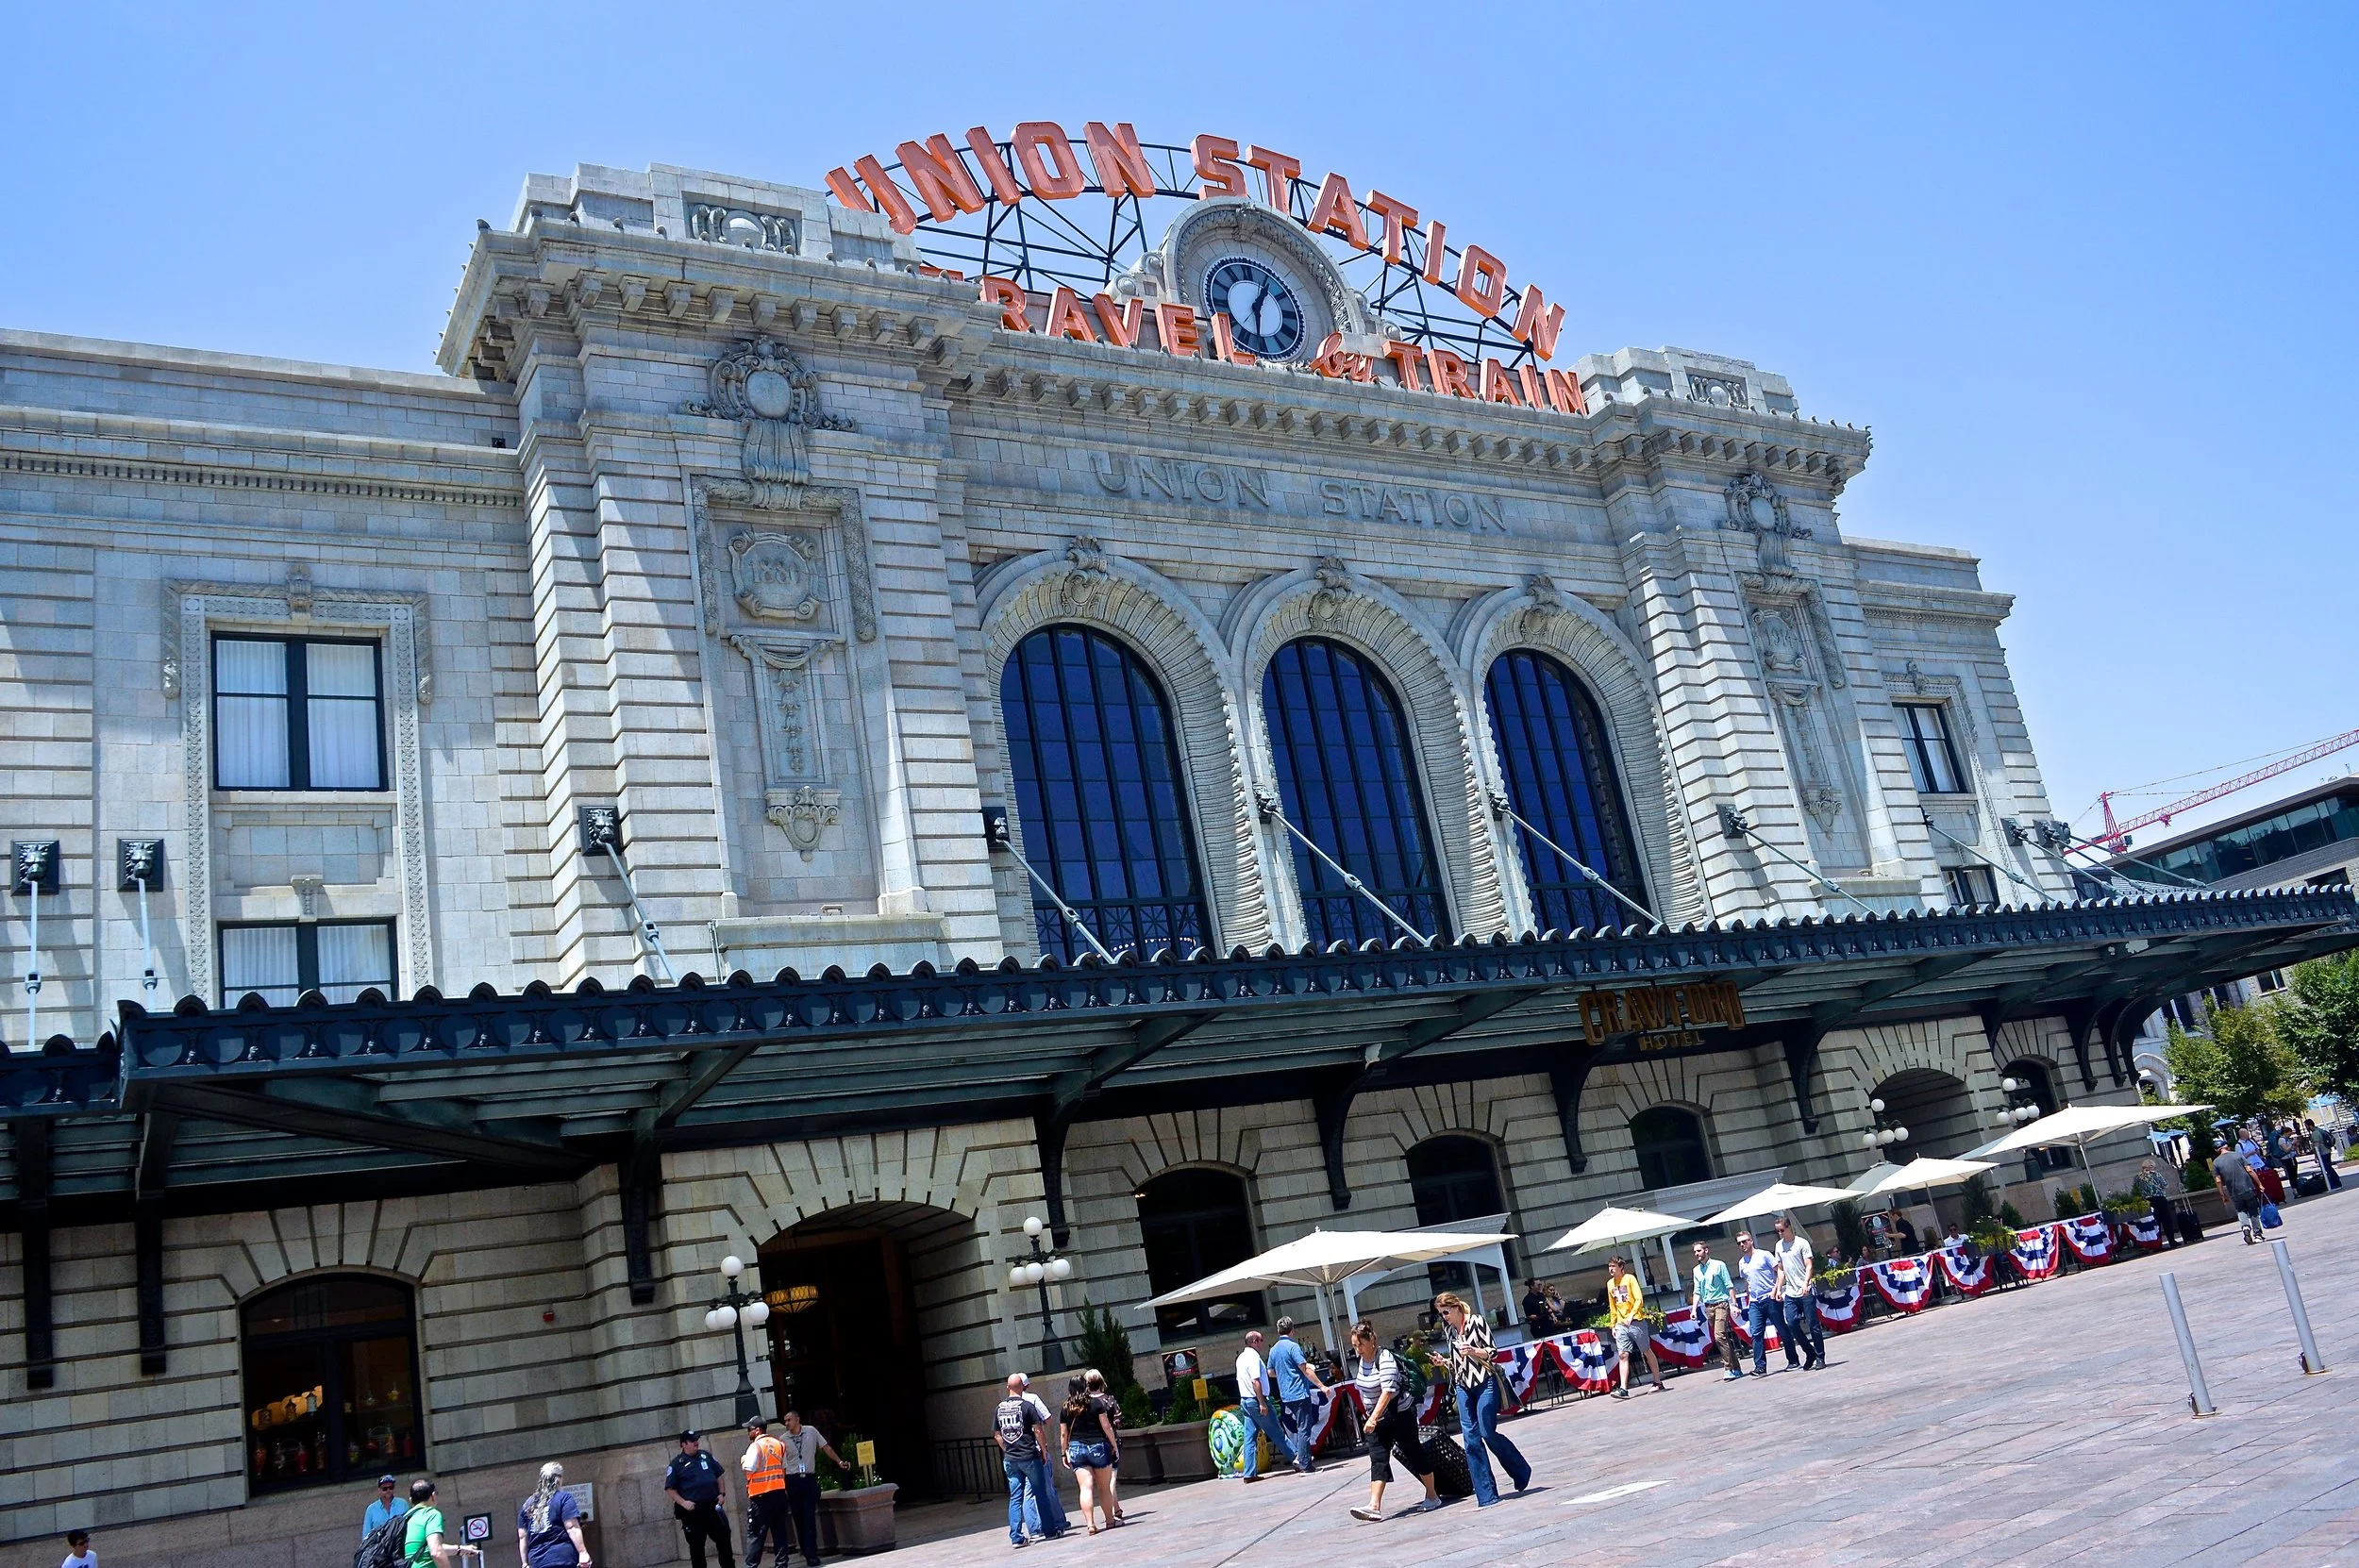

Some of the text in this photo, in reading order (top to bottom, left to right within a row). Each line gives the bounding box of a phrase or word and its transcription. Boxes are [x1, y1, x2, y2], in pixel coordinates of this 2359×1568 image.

[825, 121, 1566, 361] UNION STATION
[919, 266, 1256, 365] RAVEL
[1382, 340, 1587, 416] TRAIN
[1090, 455, 1507, 532] UNION STATION
[1577, 980, 1746, 1045] CRAWFORD
[1637, 1030, 1706, 1051] HOTEL
